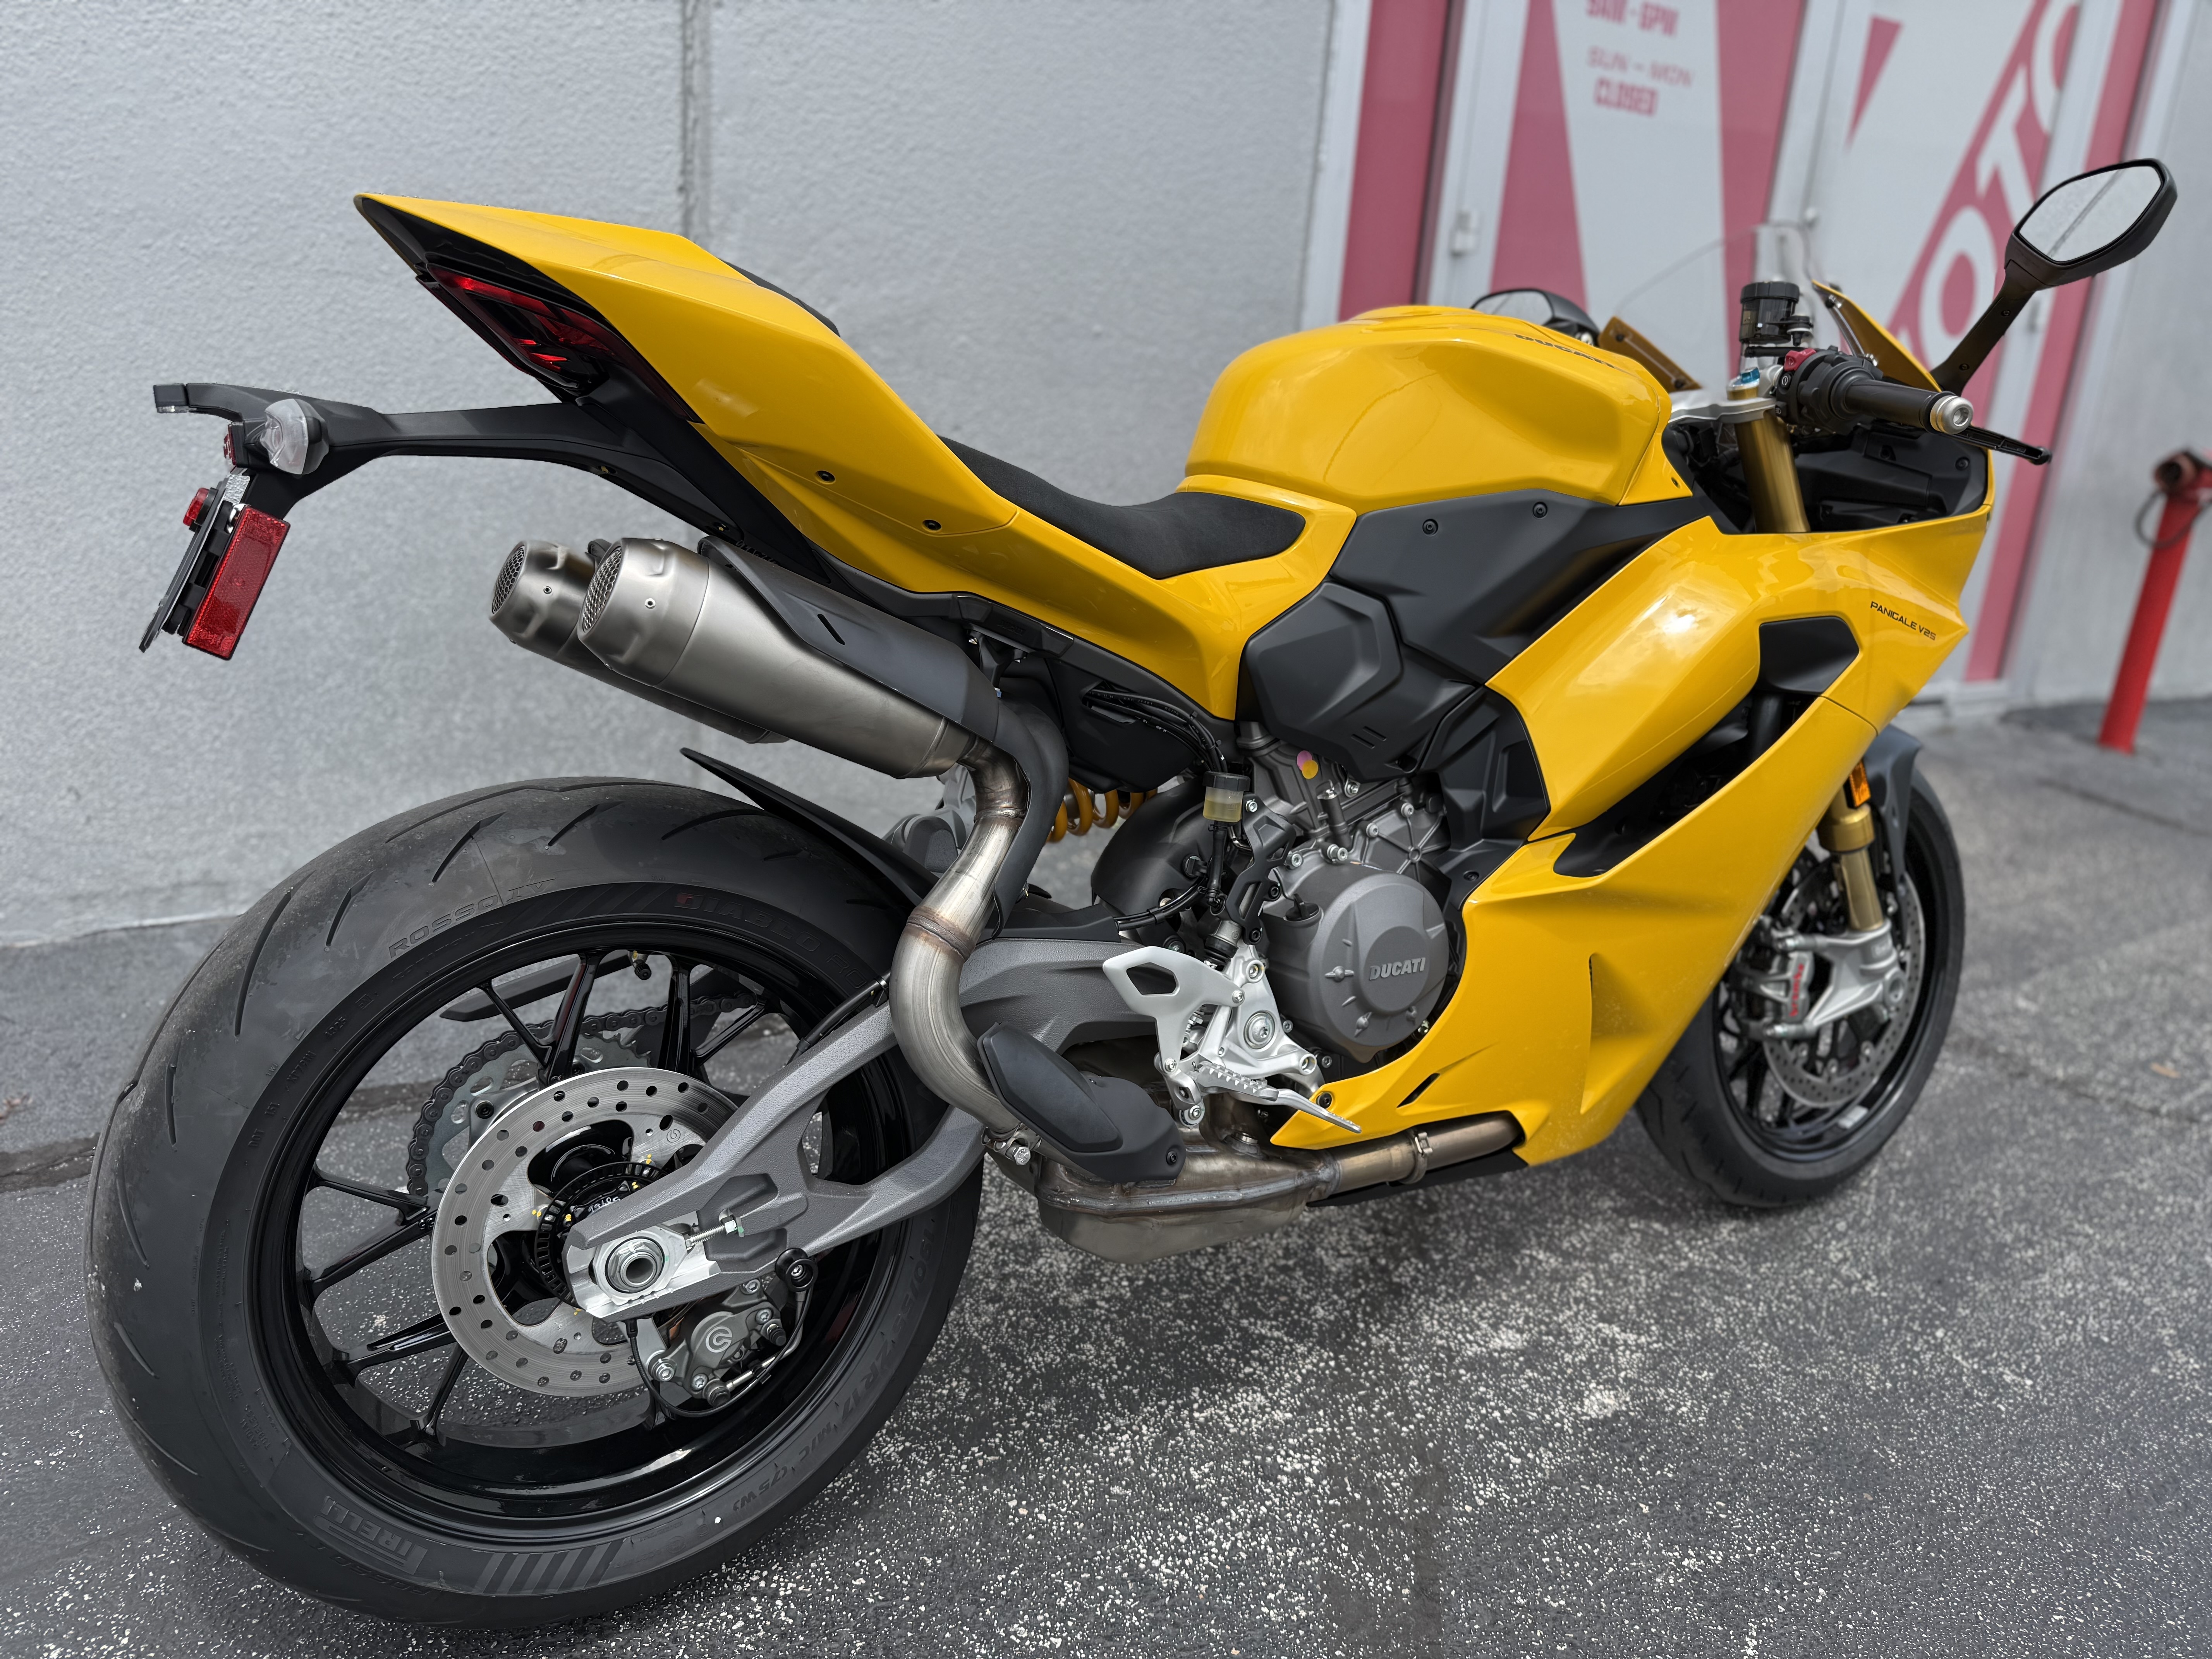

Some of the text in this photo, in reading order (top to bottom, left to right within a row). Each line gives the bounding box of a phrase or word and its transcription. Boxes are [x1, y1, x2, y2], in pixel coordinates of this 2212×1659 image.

[1594, 77, 1657, 116] CLOSED
[1870, 601, 1937, 641] PANIGALE V2S
[388, 895, 498, 958] ROSSO
[673, 892, 821, 952] DIABLO
[1369, 957, 1426, 981] DUCATI
[892, 1228, 935, 1336] 190/55
[313, 1495, 428, 1575] PIRELLI
